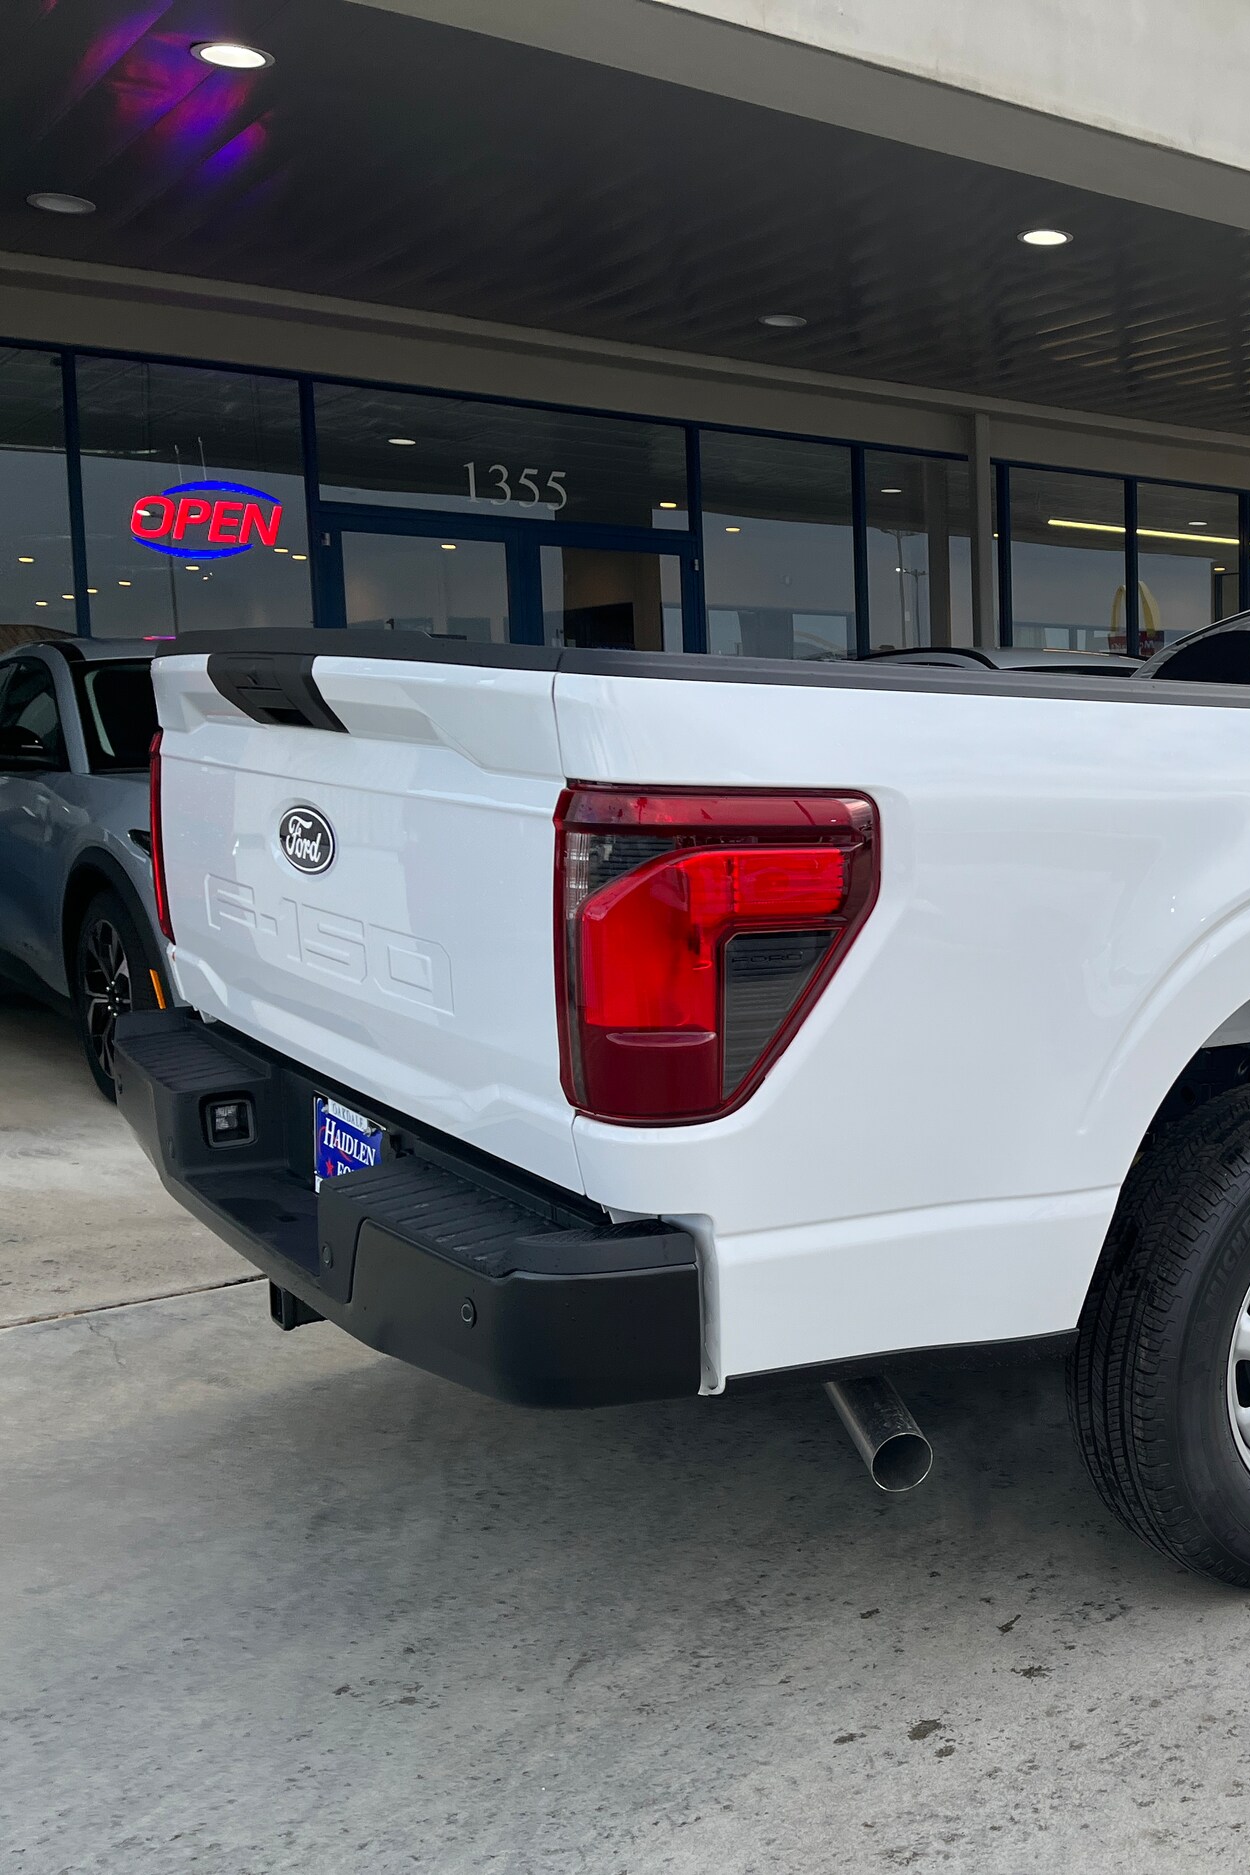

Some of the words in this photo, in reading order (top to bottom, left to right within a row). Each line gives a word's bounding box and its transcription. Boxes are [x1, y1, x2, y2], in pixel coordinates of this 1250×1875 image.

[463, 462, 567, 511] 1355
[131, 495, 283, 546] OPEN
[286, 815, 322, 863] Ford
[204, 873, 455, 1016] F-150
[323, 1117, 376, 1166] HAIDLEN
